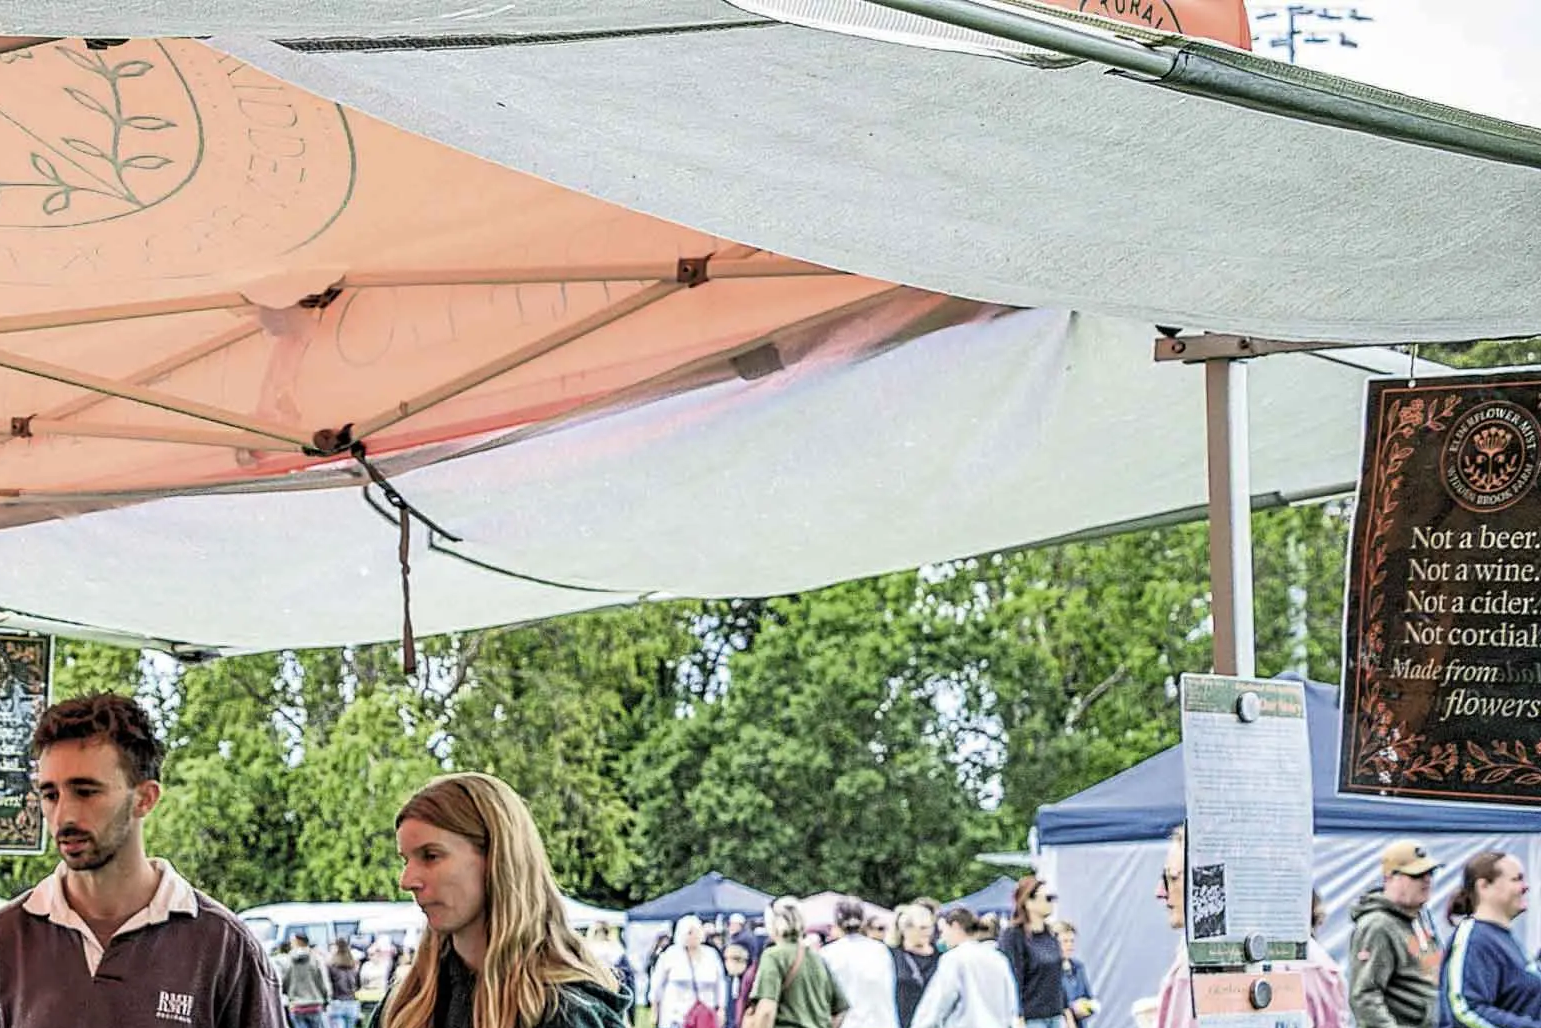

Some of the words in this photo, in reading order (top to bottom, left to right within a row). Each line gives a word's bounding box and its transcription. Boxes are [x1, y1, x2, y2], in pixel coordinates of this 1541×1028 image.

[1410, 526, 1454, 549] Not
[1459, 531, 1473, 549] a
[1479, 524, 1541, 550] beer.
[1407, 558, 1451, 581] Not
[1454, 563, 1468, 581] a
[1474, 558, 1540, 582] wine.
[1404, 590, 1448, 613] Not
[1451, 596, 1464, 613] a
[1402, 621, 1444, 645] Not
[1390, 658, 1443, 680] Made
[1439, 659, 1498, 687] from
[1439, 688, 1541, 722] flowers
